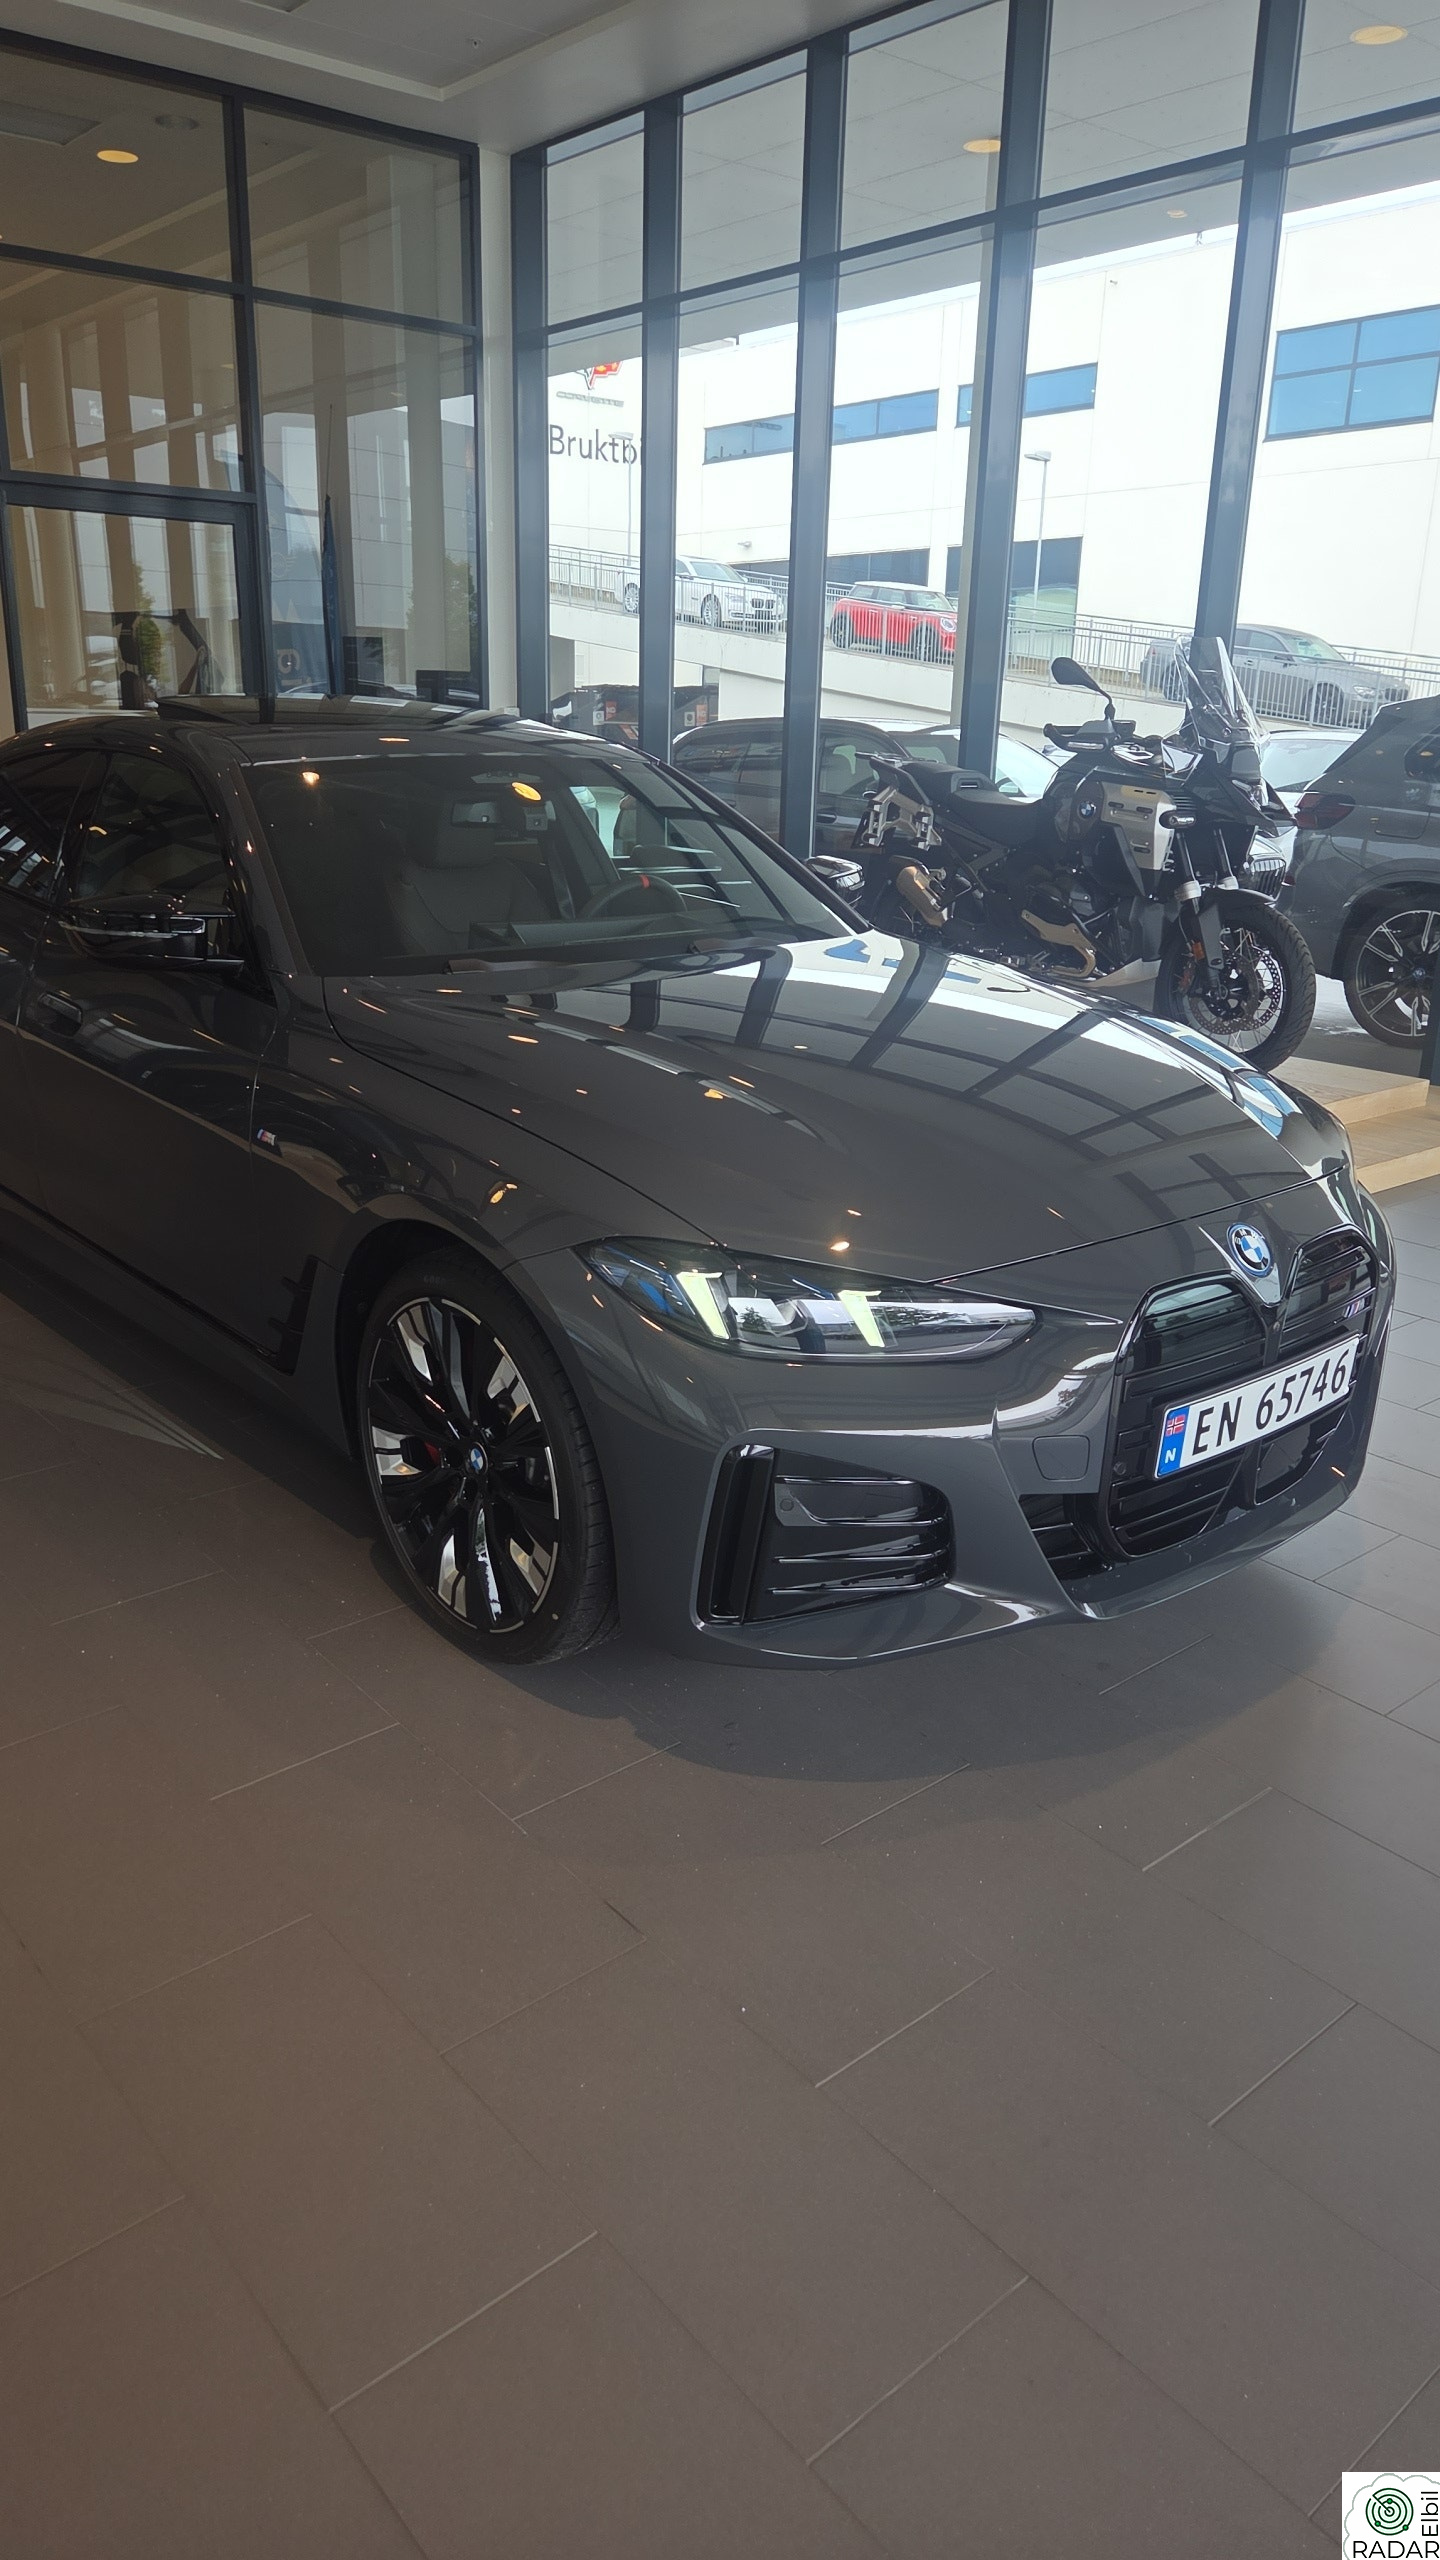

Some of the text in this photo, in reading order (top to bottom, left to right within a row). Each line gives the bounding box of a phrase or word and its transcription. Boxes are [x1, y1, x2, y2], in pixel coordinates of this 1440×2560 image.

[549, 423, 641, 466] Bruktb
[1192, 1349, 1350, 1456] EN 65746
[1165, 1448, 1177, 1464] N
